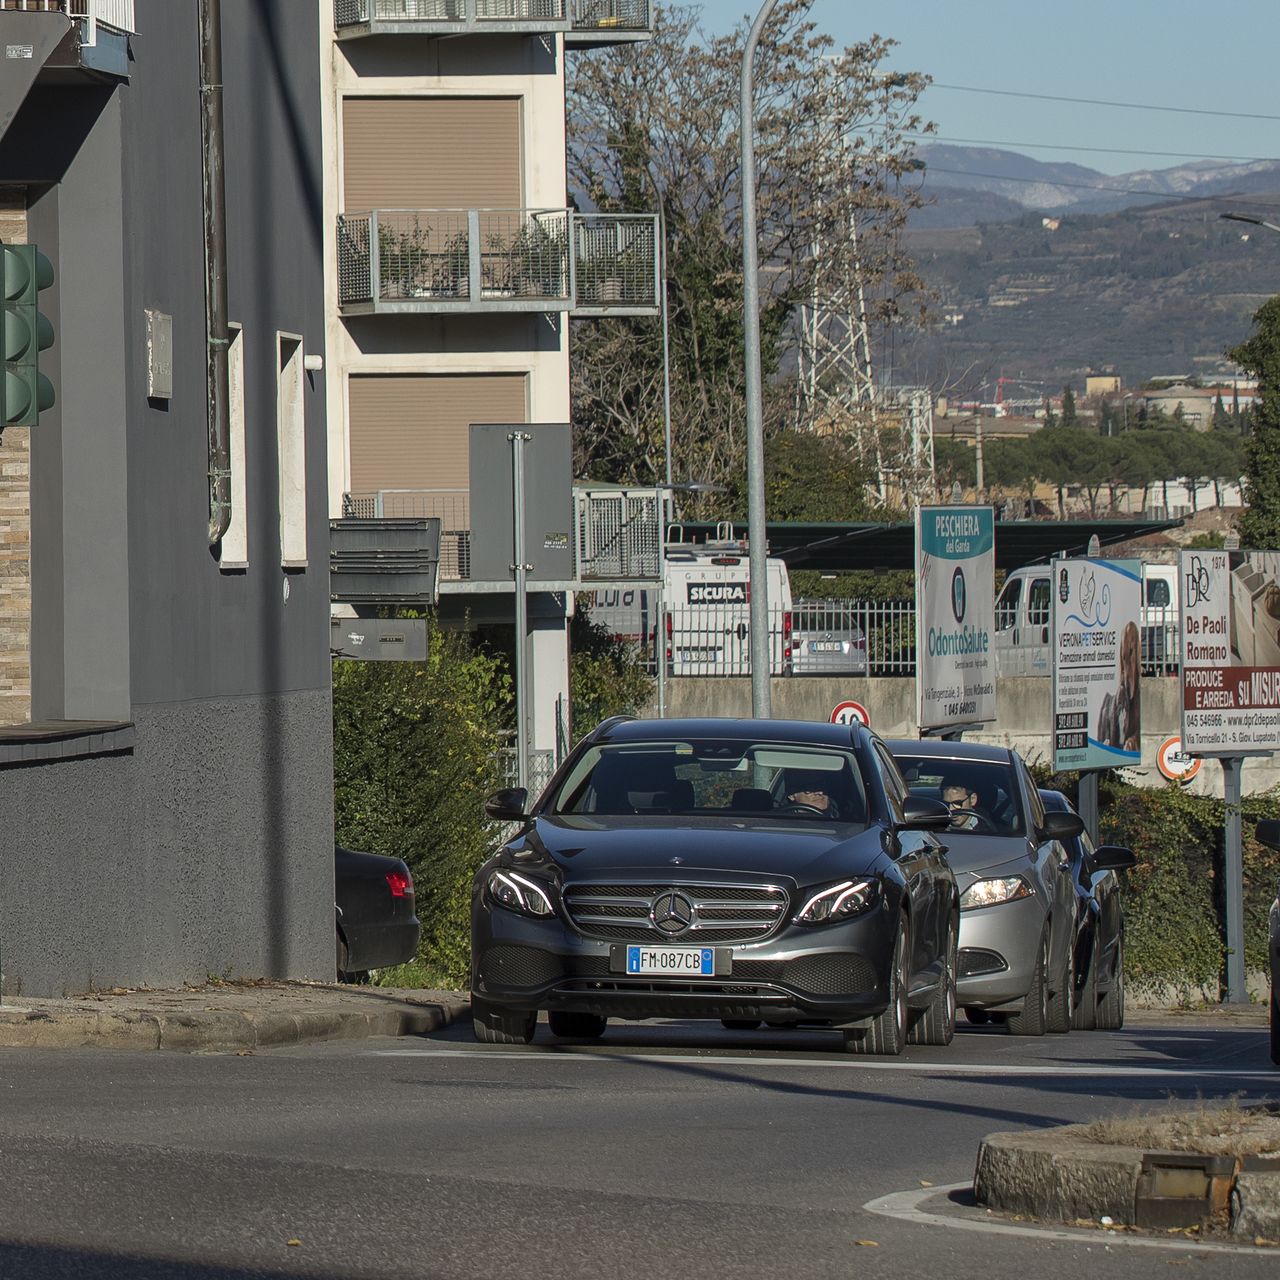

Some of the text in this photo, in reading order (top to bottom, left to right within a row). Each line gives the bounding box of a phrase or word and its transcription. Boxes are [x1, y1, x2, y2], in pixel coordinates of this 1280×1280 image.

[935, 515, 980, 537] PESCHIERA
[946, 539, 970, 553] del Garda
[1212, 556, 1226, 569] 1974
[690, 587, 745, 600] SICURA
[1186, 616, 1227, 634] De Paoli
[928, 624, 989, 657] OdontoSalute
[1187, 642, 1227, 660] Romano
[1185, 671, 1224, 688] PRODUCE
[1196, 691, 1202, 708] E
[1202, 691, 1235, 708] ARREDA
[1186, 714, 1198, 727] 045
